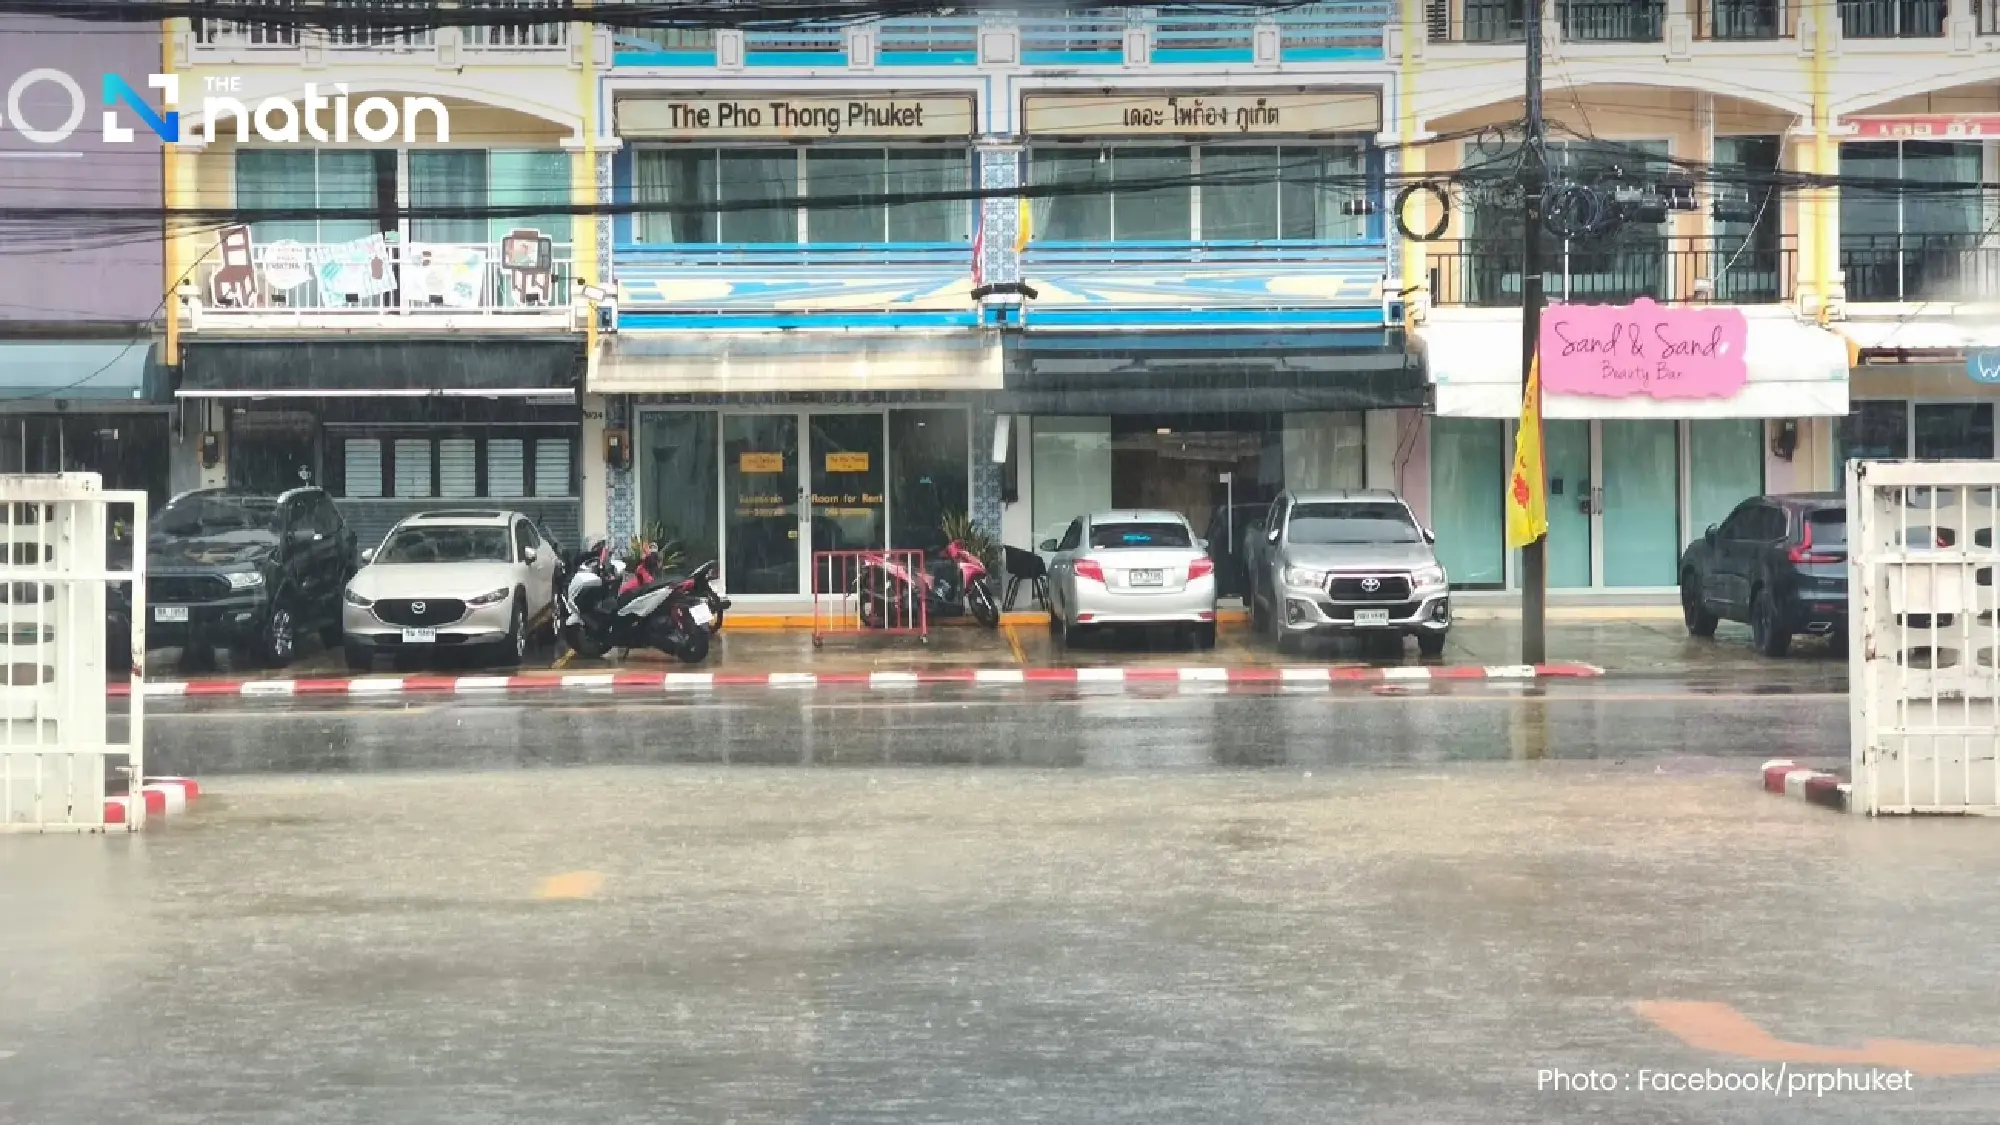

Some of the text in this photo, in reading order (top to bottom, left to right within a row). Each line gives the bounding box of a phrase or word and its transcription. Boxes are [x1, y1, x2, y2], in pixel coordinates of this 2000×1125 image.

[668, 102, 923, 133] The Pho Thong Phuket
[1124, 107, 1163, 126] เดอะ
[1236, 98, 1279, 132] ภูเก็ต
[1554, 321, 1722, 359] Sand & Sand
[1601, 360, 1683, 389] Beauty Bar
[811, 493, 839, 504] Room
